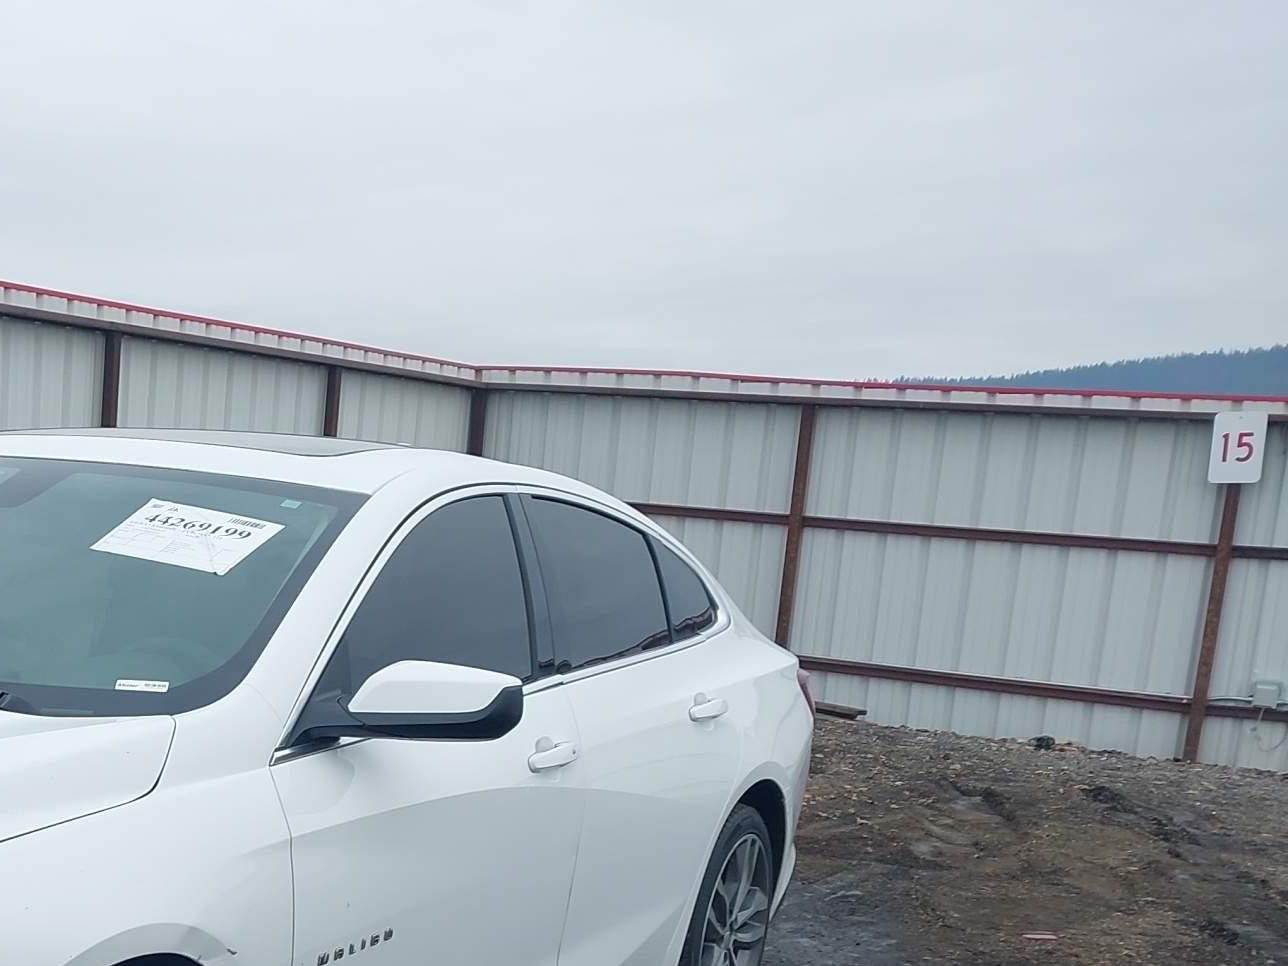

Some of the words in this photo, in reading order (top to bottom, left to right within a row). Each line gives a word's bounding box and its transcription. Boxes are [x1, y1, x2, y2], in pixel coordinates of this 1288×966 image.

[1221, 432, 1255, 463] 15
[144, 513, 253, 541] 44269199
[316, 927, 394, 966] MALIBU
